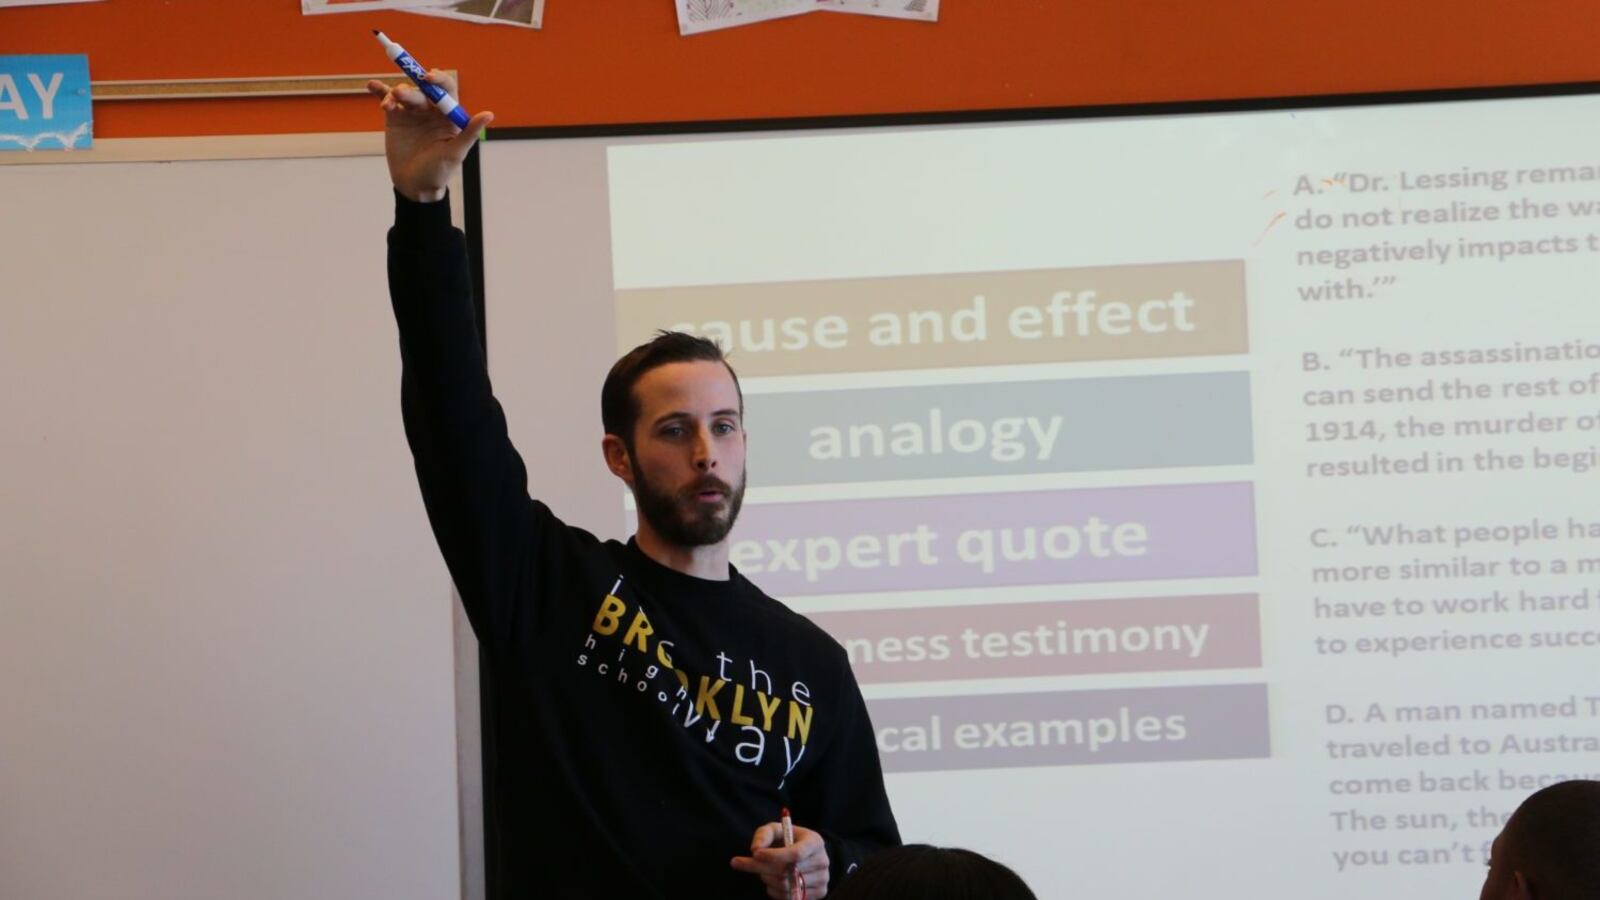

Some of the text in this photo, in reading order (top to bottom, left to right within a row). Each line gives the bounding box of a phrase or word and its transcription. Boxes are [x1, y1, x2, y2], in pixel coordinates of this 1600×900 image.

[0, 73, 65, 119] AY
[1293, 174, 1324, 195] A.
[1399, 166, 1508, 190] Lessing
[1516, 165, 1600, 183] rema
[1295, 208, 1333, 230] do
[1342, 207, 1393, 228] not
[1402, 202, 1500, 224] realize
[1508, 198, 1559, 219] the
[1297, 238, 1450, 270] negatively
[1459, 235, 1578, 261] impacts
[672, 289, 1195, 353] ause and effect
[1302, 352, 1331, 371] B.
[1420, 339, 1600, 366] assassinatio
[1303, 387, 1354, 406] can
[1363, 379, 1434, 403] send
[1441, 376, 1492, 401] the
[1502, 376, 1560, 398] rest
[808, 407, 1064, 462] analogy
[1306, 409, 1600, 443] 1914, the murder o
[1306, 444, 1600, 478] resulted in the begi
[728, 515, 1149, 582] expert quote
[1310, 528, 1337, 548] C.
[1454, 517, 1559, 547] people
[1312, 565, 1391, 583] more
[1400, 556, 1500, 580] similar
[1509, 556, 1541, 576] to
[1550, 559, 1568, 575] a
[1314, 597, 1386, 619] have
[1392, 597, 1425, 616] to
[1433, 591, 1510, 615] work
[1519, 588, 1589, 611] hard
[847, 620, 1209, 664] ness testimony
[1315, 635, 1348, 655] to
[1356, 628, 1523, 658] experience
[716, 651, 812, 707] the
[1325, 704, 1354, 724] D.
[1364, 703, 1387, 723] A
[1395, 704, 1462, 722] man
[1471, 696, 1577, 720] named
[878, 707, 1187, 752] cal examples
[1326, 734, 1600, 760] traveled to Austra
[1329, 776, 1412, 795] come
[1419, 770, 1491, 793] back
[1329, 810, 1388, 832] The
[1395, 812, 1458, 831] sun,
[1331, 848, 1389, 872] you
[1397, 842, 1475, 866] can’t
